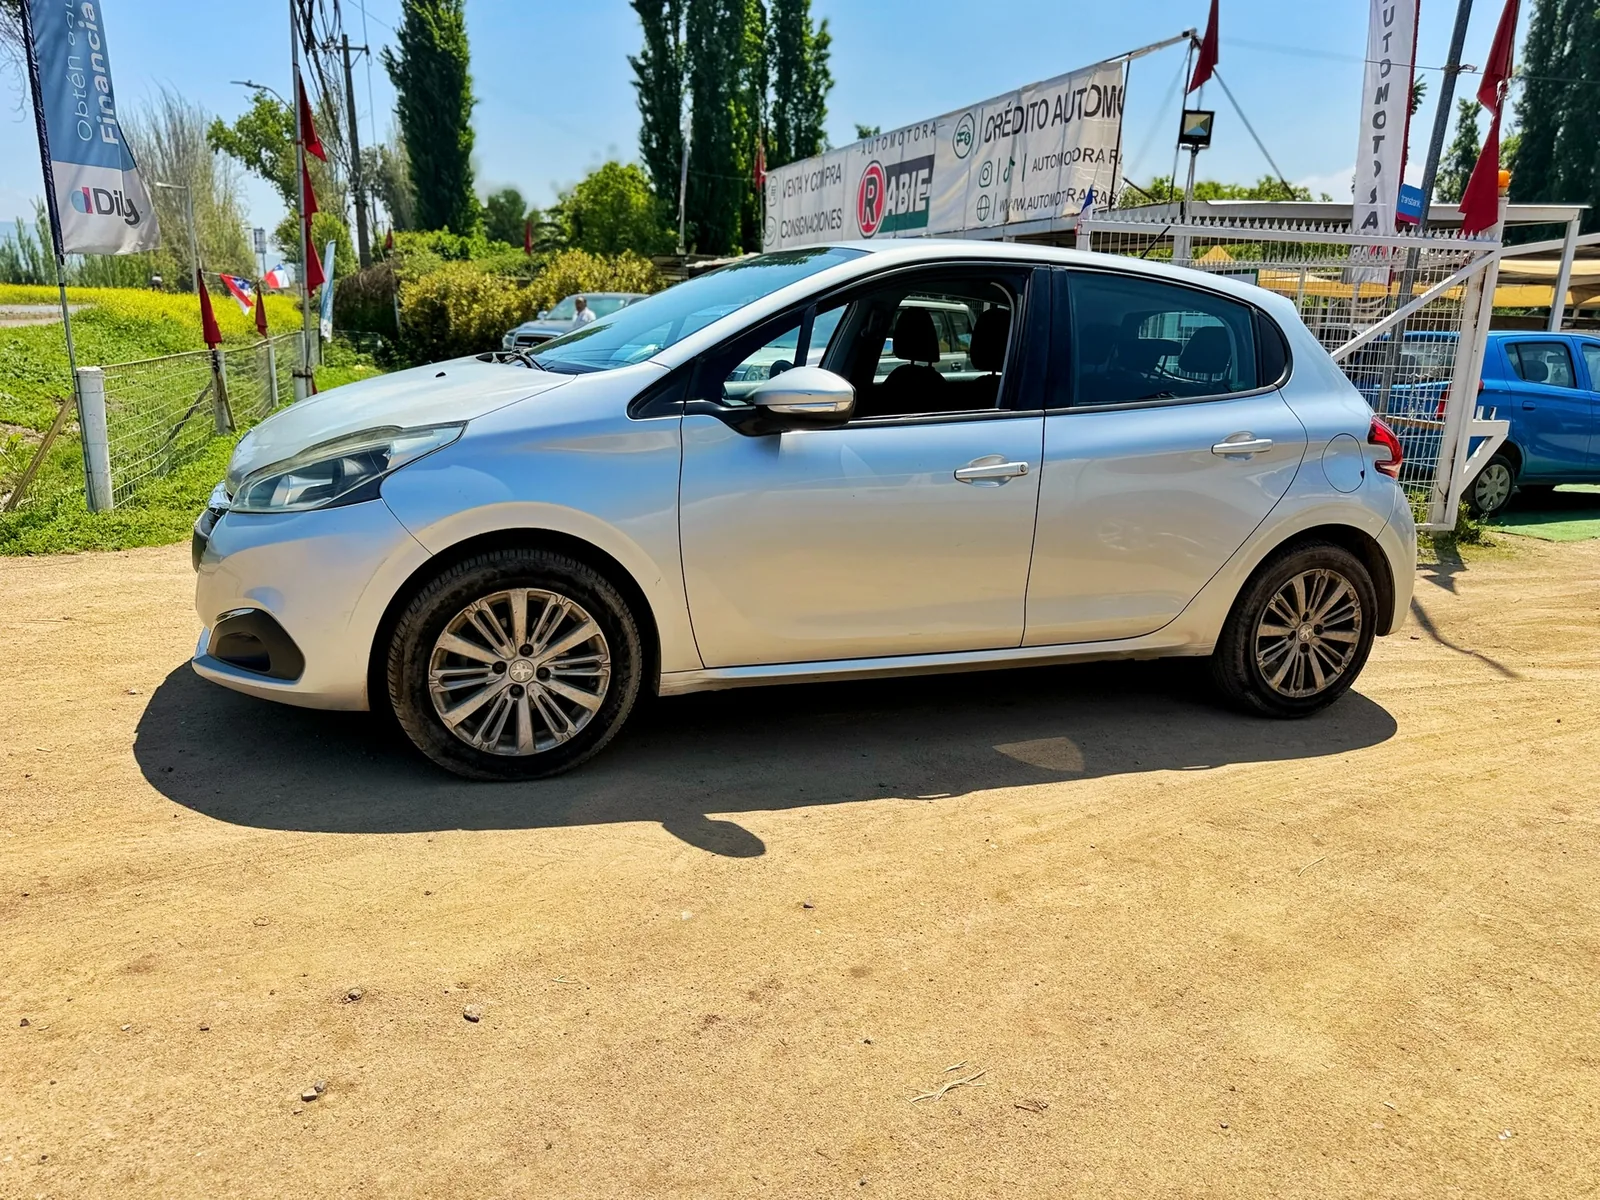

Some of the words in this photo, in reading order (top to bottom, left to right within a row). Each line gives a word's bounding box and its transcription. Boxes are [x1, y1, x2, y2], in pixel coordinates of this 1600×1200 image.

[66, 55, 93, 141] Obtén
[861, 121, 937, 156] AUTOMOTORA
[983, 101, 1049, 143] CRÉDITO
[782, 176, 803, 199] VENTA
[804, 173, 810, 193] Y
[810, 163, 842, 192] COMPRA
[859, 166, 932, 228] RABIE
